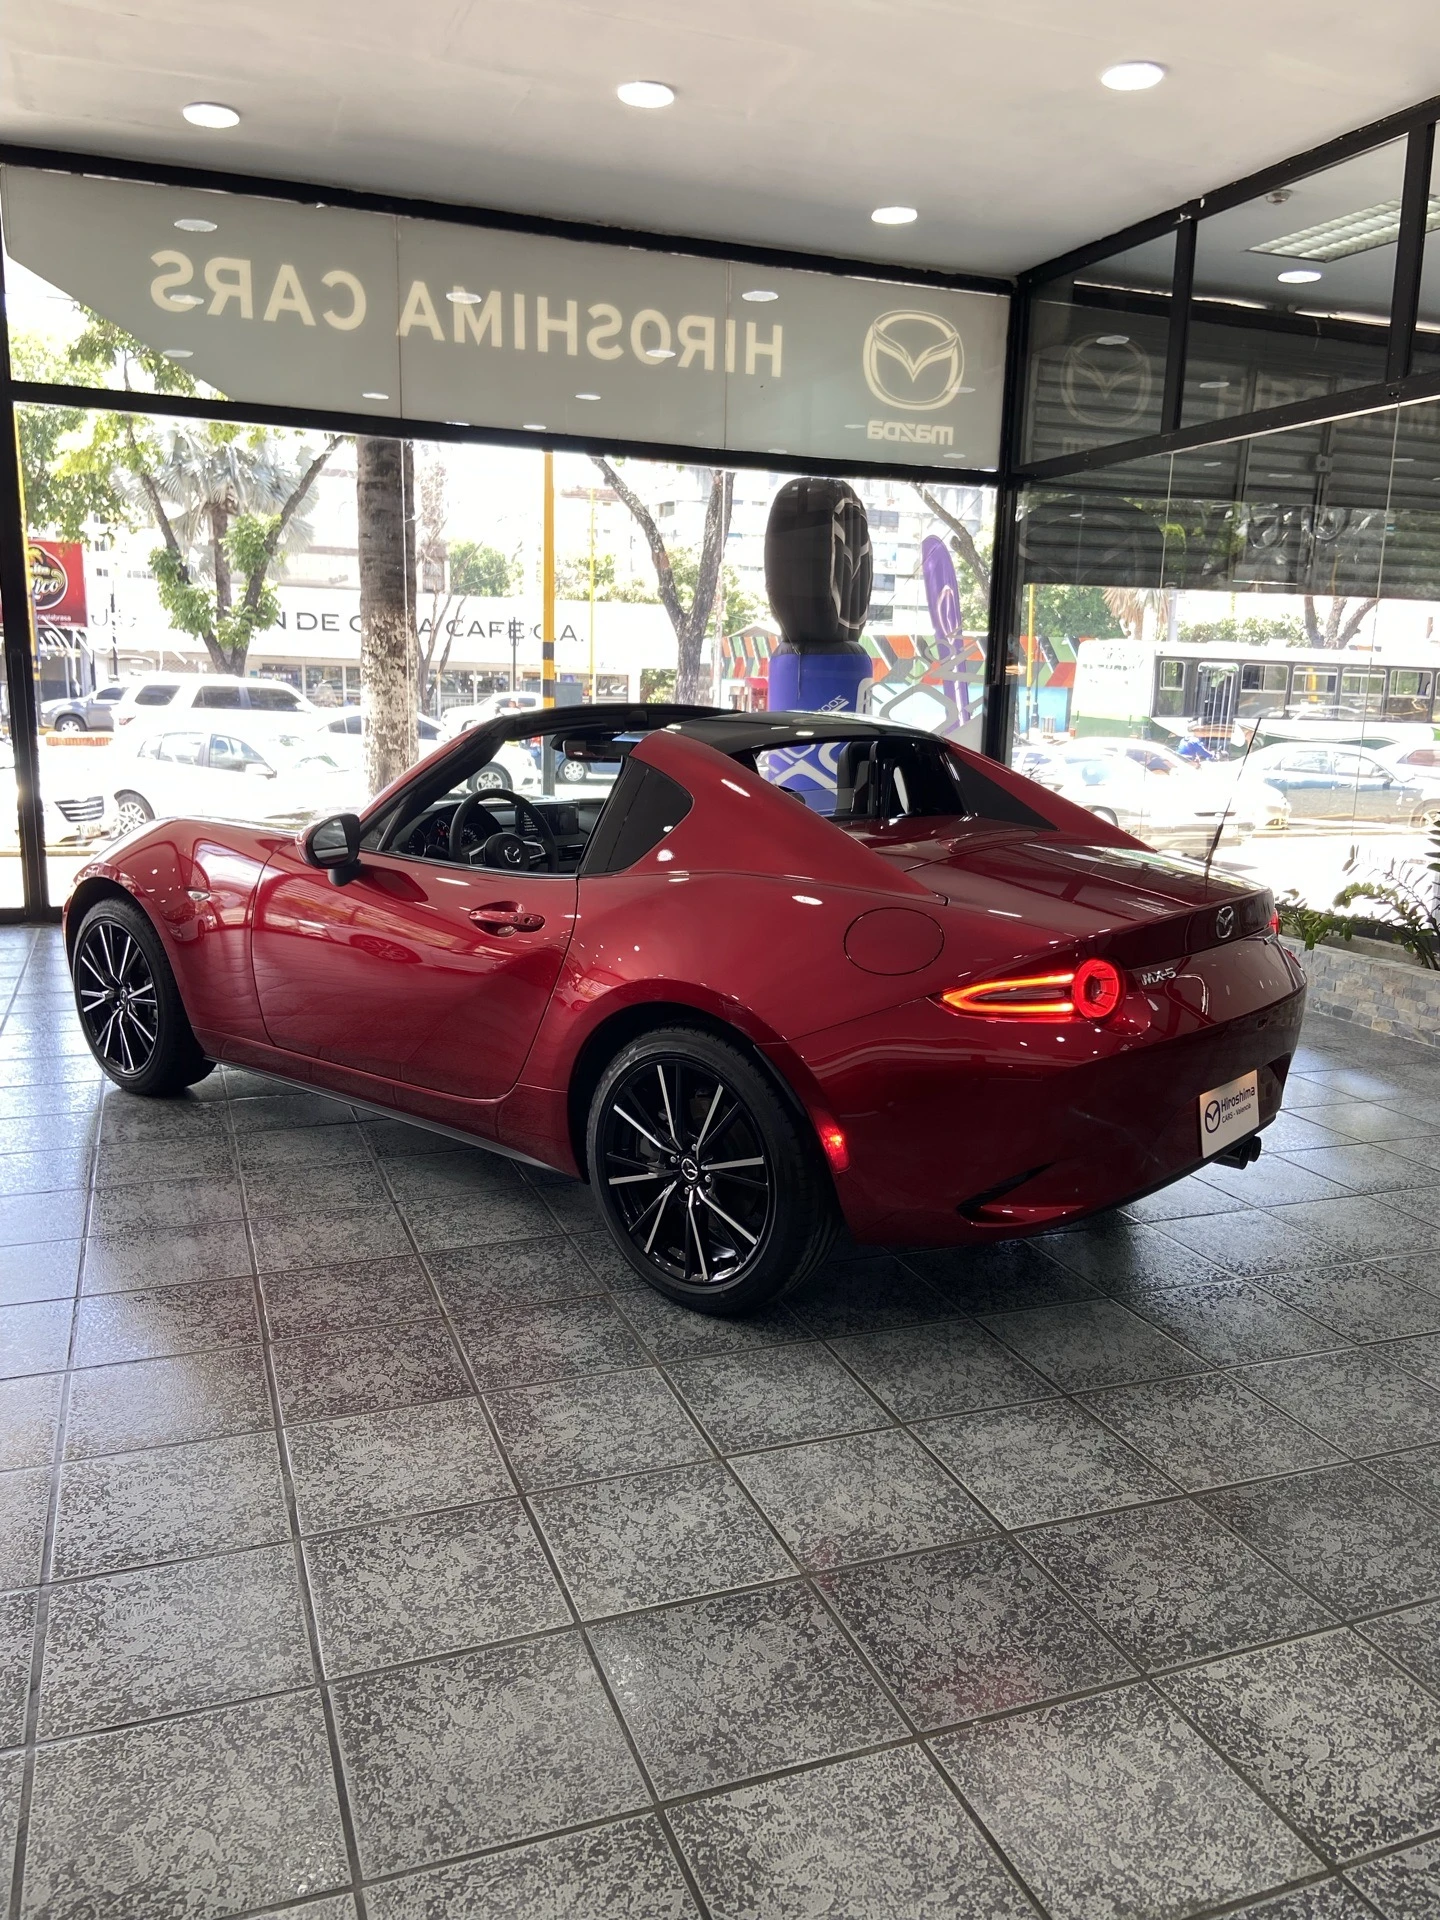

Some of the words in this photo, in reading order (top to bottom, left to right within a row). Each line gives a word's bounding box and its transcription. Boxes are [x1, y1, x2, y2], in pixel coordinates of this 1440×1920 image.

[296, 611, 340, 632] DE
[1141, 967, 1177, 986] MX-5
[1220, 1087, 1255, 1112] Hiroshima
[1221, 1112, 1234, 1123] CARS
[1235, 1103, 1251, 1115] Valencia
